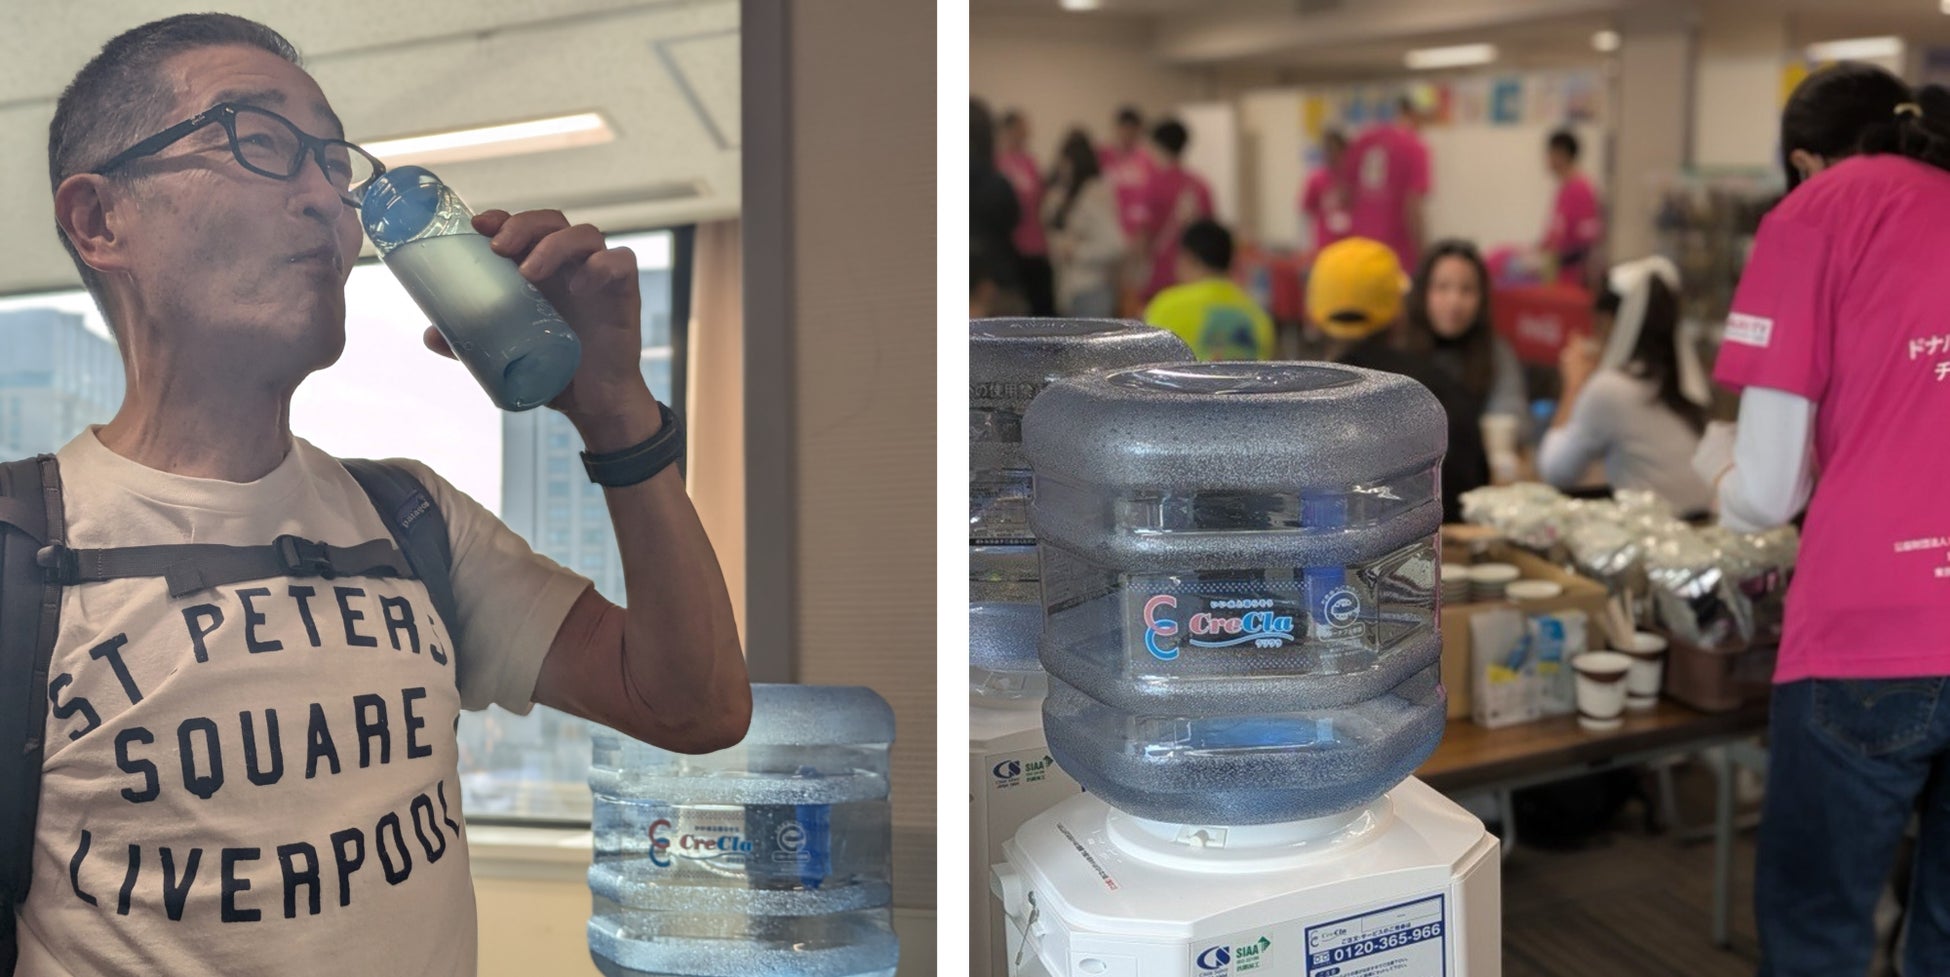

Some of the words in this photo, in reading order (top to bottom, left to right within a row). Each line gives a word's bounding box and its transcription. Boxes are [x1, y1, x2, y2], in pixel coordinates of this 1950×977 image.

[1189, 611, 1294, 634] CreCla
[49, 633, 143, 741] ST
[114, 686, 432, 803] SQUARE
[69, 780, 460, 922] LIVERPOOL
[680, 834, 753, 852] CreCla
[1236, 945, 1259, 958] SIAA
[1334, 923, 1440, 961] 0120-365-966
